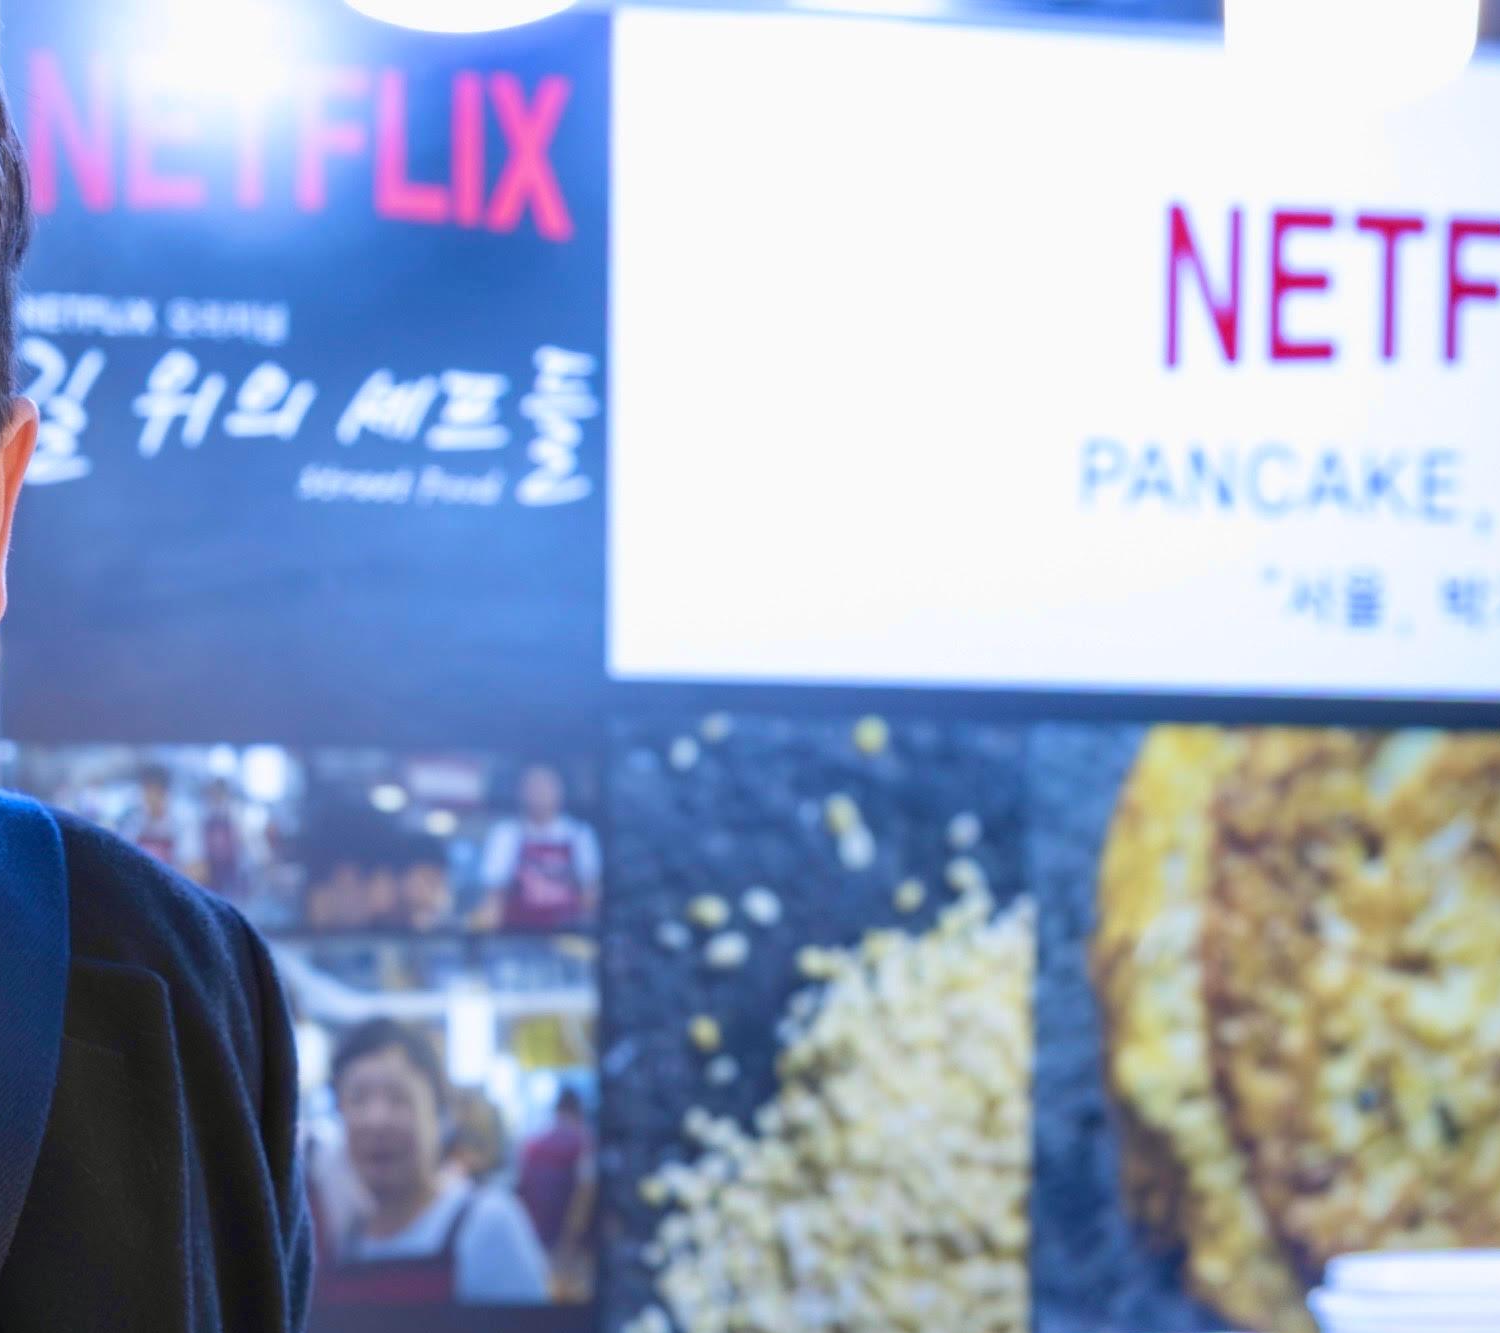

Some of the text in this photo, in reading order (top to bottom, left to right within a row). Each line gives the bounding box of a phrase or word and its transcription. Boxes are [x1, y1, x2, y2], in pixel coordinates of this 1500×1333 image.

[26, 48, 574, 242] NETFLIX
[132, 348, 317, 457] 위의
[1080, 437, 1495, 535] PANCAKE,
